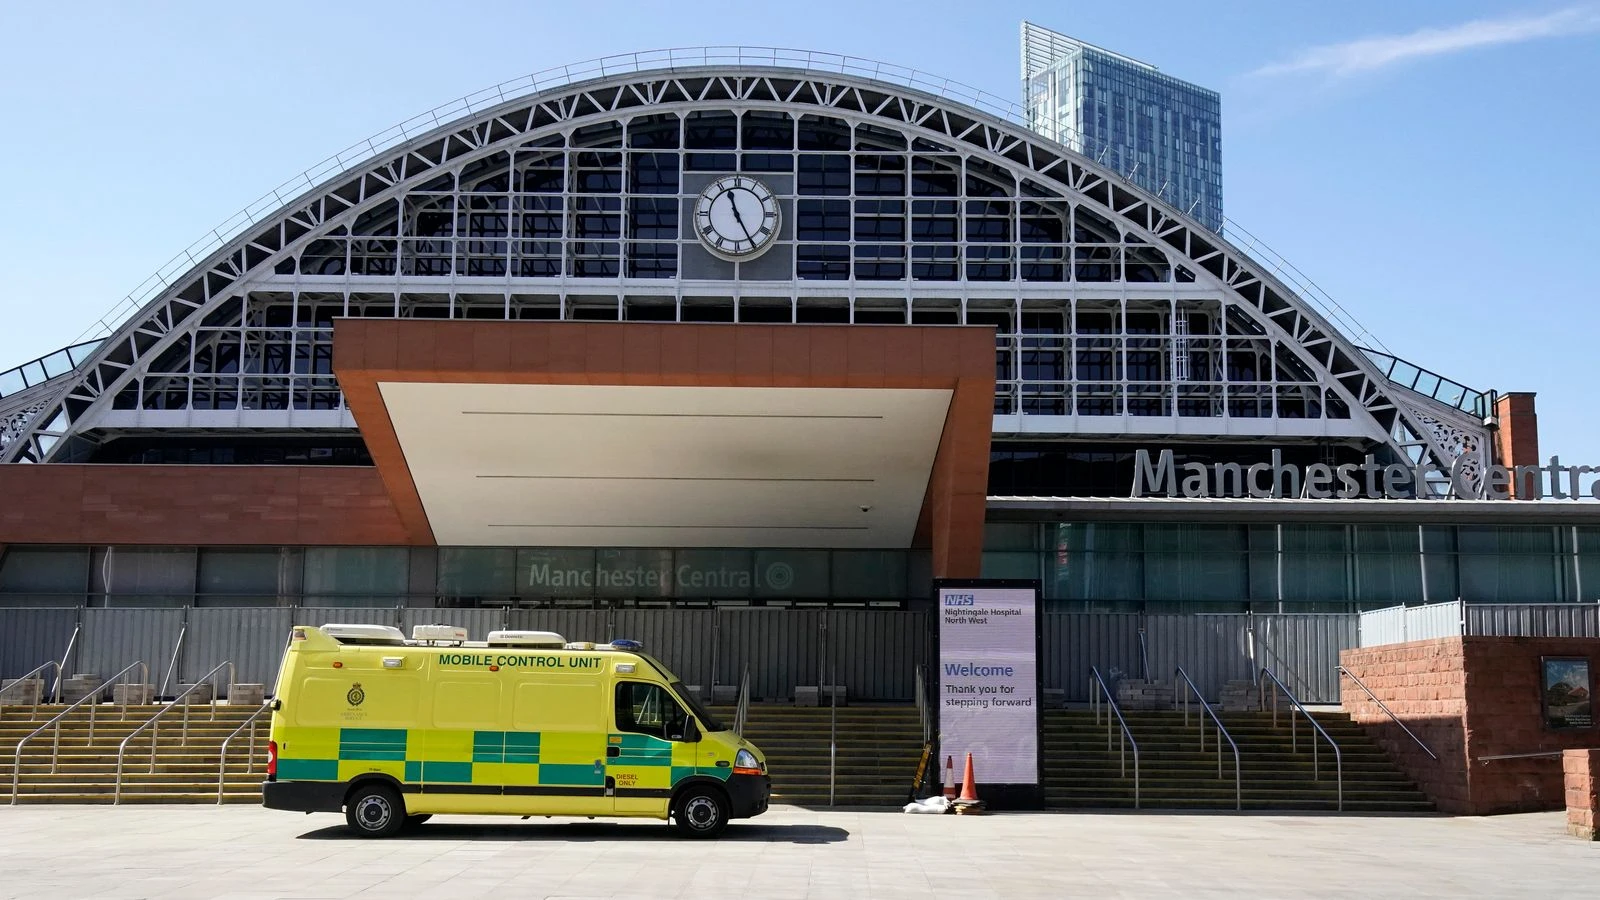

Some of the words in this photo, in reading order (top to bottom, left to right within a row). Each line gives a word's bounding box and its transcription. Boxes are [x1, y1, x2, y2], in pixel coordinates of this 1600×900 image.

[1134, 448, 1437, 499] Manchester
[529, 563, 667, 588] Manchester
[676, 563, 761, 588] Central
[945, 595, 973, 605] NHS
[945, 608, 988, 617] Nightingale
[990, 608, 1022, 617] Hospital
[439, 654, 493, 666] MOBILE
[496, 655, 565, 668] CONTROL
[569, 657, 602, 669] UNIT
[944, 662, 1014, 677] Welcome
[945, 684, 976, 694] Thank
[978, 686, 998, 696] you
[999, 684, 1015, 694] for
[945, 697, 989, 709] stepping
[991, 696, 1032, 707] forward
